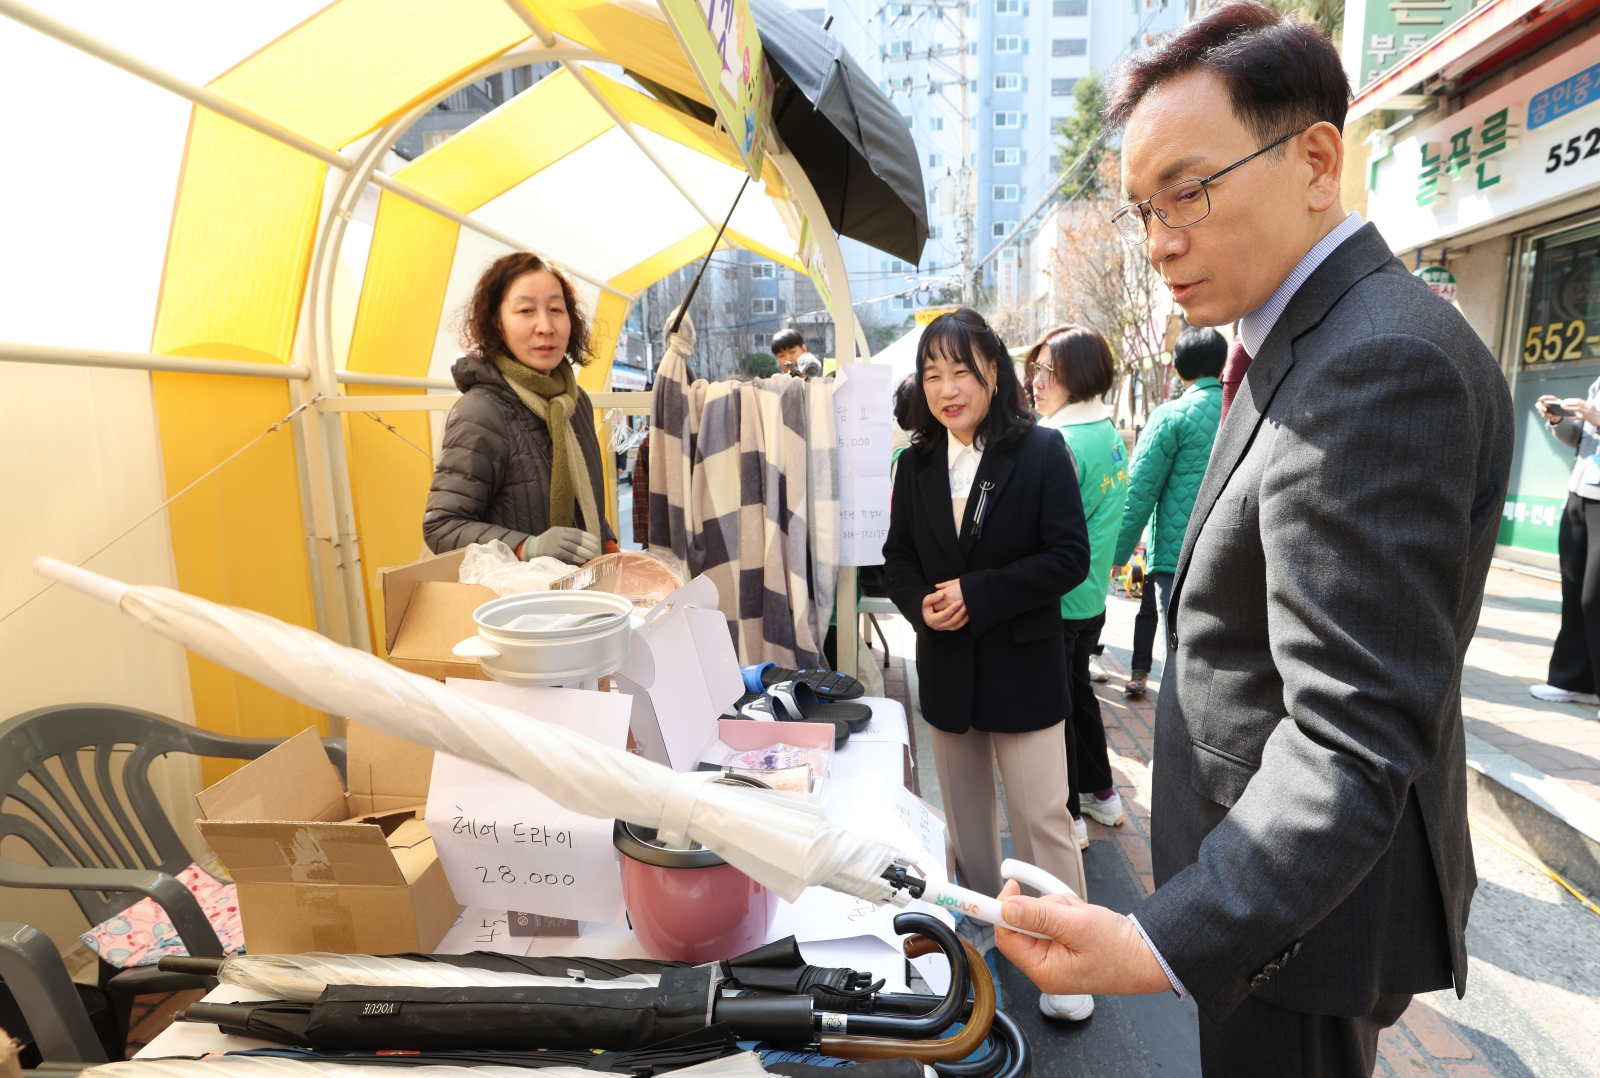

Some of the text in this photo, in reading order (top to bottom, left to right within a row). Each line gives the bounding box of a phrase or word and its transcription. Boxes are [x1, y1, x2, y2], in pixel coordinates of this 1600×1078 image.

[1416, 107, 1509, 208] 늘푸른
[1544, 127, 1600, 174] 552
[452, 805, 573, 849] 헤어 드라이
[475, 865, 575, 885] 28.000
[362, 1003, 394, 1015] VOGUE
